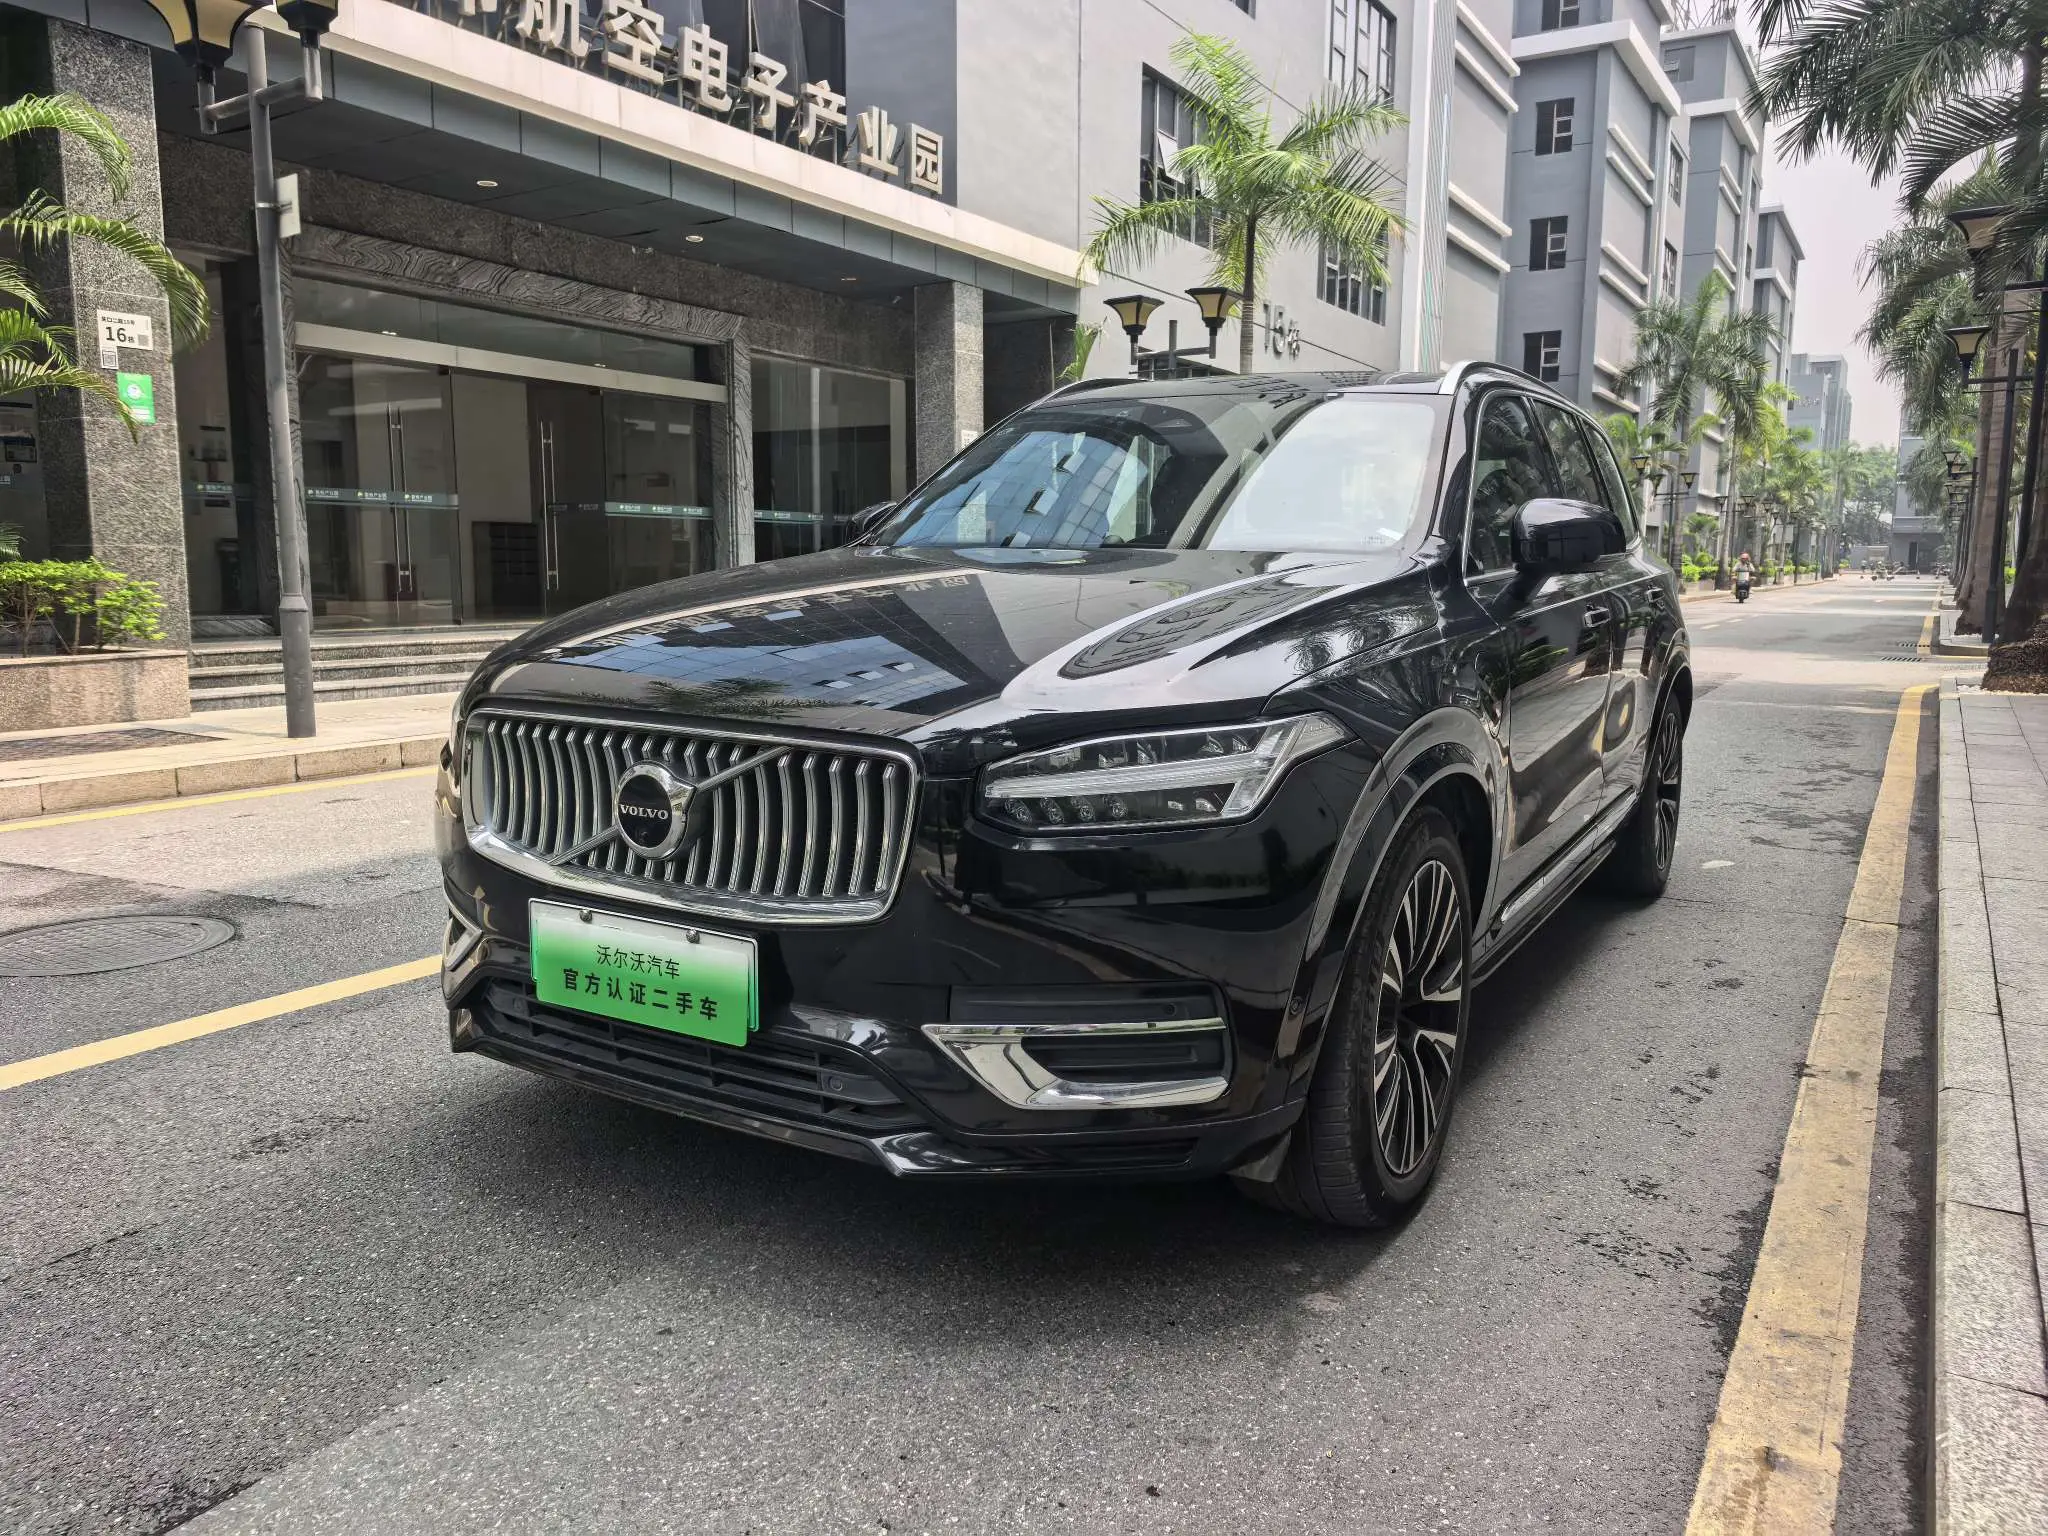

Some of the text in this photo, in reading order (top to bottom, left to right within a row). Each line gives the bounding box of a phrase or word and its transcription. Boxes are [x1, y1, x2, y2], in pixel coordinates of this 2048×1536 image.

[459, 0, 943, 194] 航空电子产业园
[619, 803, 669, 820] VOLVO
[596, 944, 680, 980] 沃尔沃汽车
[563, 968, 718, 1021] 官方认证二手车
